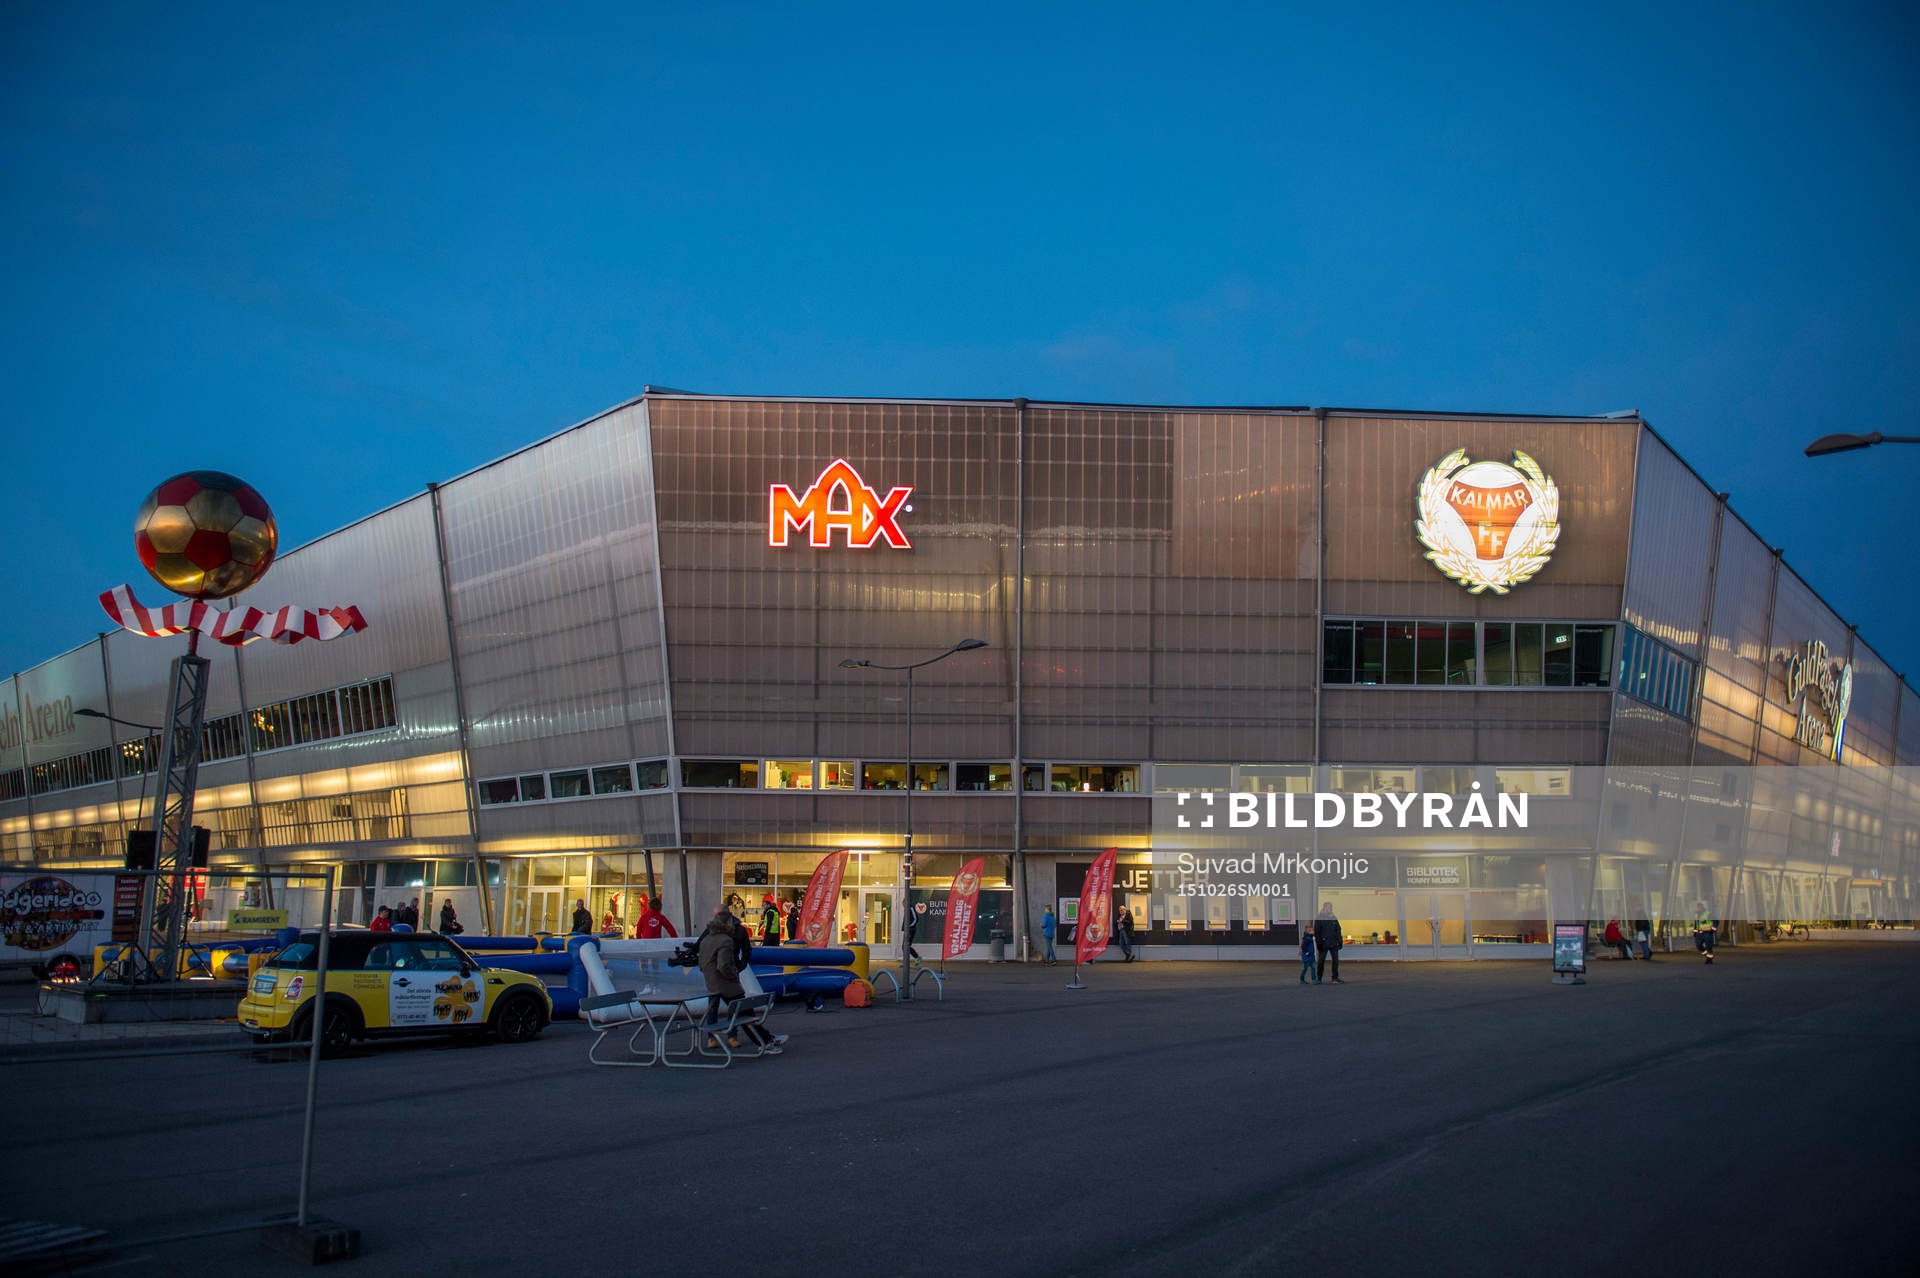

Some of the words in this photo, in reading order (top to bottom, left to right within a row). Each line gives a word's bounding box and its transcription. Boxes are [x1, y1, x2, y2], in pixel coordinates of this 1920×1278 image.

[769, 458, 914, 549] MAX
[1451, 485, 1529, 512] KALMAR
[25, 692, 75, 742] Arena
[1796, 695, 1826, 751] Arena
[1406, 866, 1459, 877] BIBLIOTEK
[960, 903, 972, 950] STOLTHET
